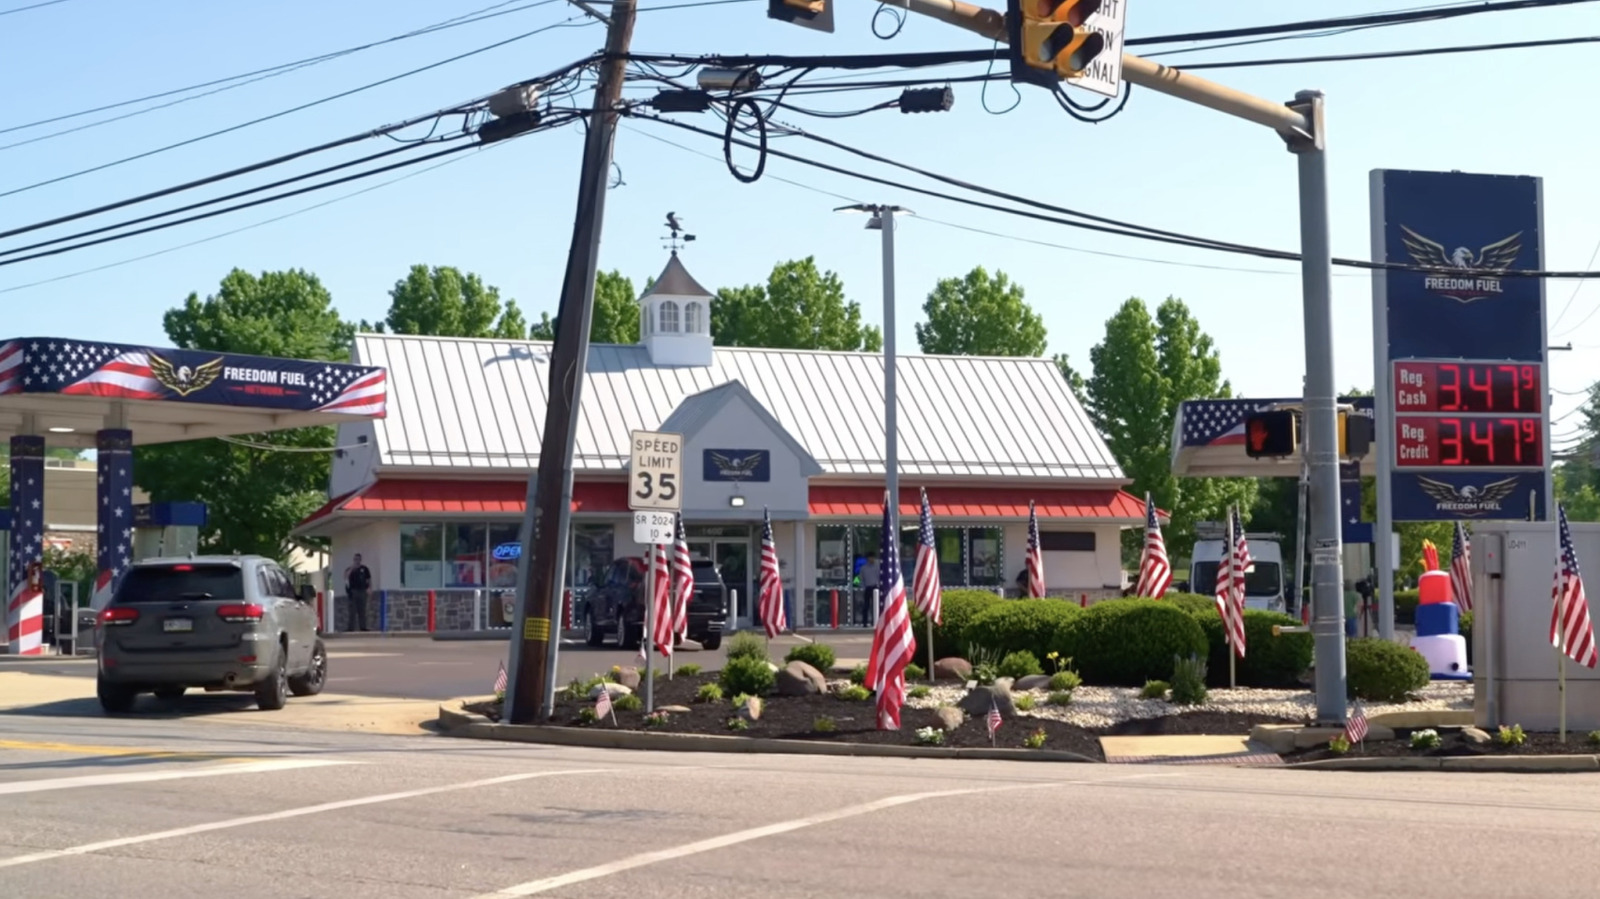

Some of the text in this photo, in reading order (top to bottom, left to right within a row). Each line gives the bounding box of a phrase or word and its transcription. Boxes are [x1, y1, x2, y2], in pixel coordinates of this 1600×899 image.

[1083, 59, 1116, 85] GNAL
[1425, 277, 1503, 292] FREEDOM FUEL
[224, 366, 307, 386] FREEDOM FUEL
[1398, 390, 1427, 405] Cash
[635, 439, 679, 454] SPEED
[1400, 444, 1429, 459] Credit
[639, 456, 673, 469] LIMIT
[635, 471, 676, 501] 35
[1436, 503, 1502, 511] FREEDOM FUEL
[635, 515, 674, 526] SR 2024
[650, 529, 659, 538] 10
